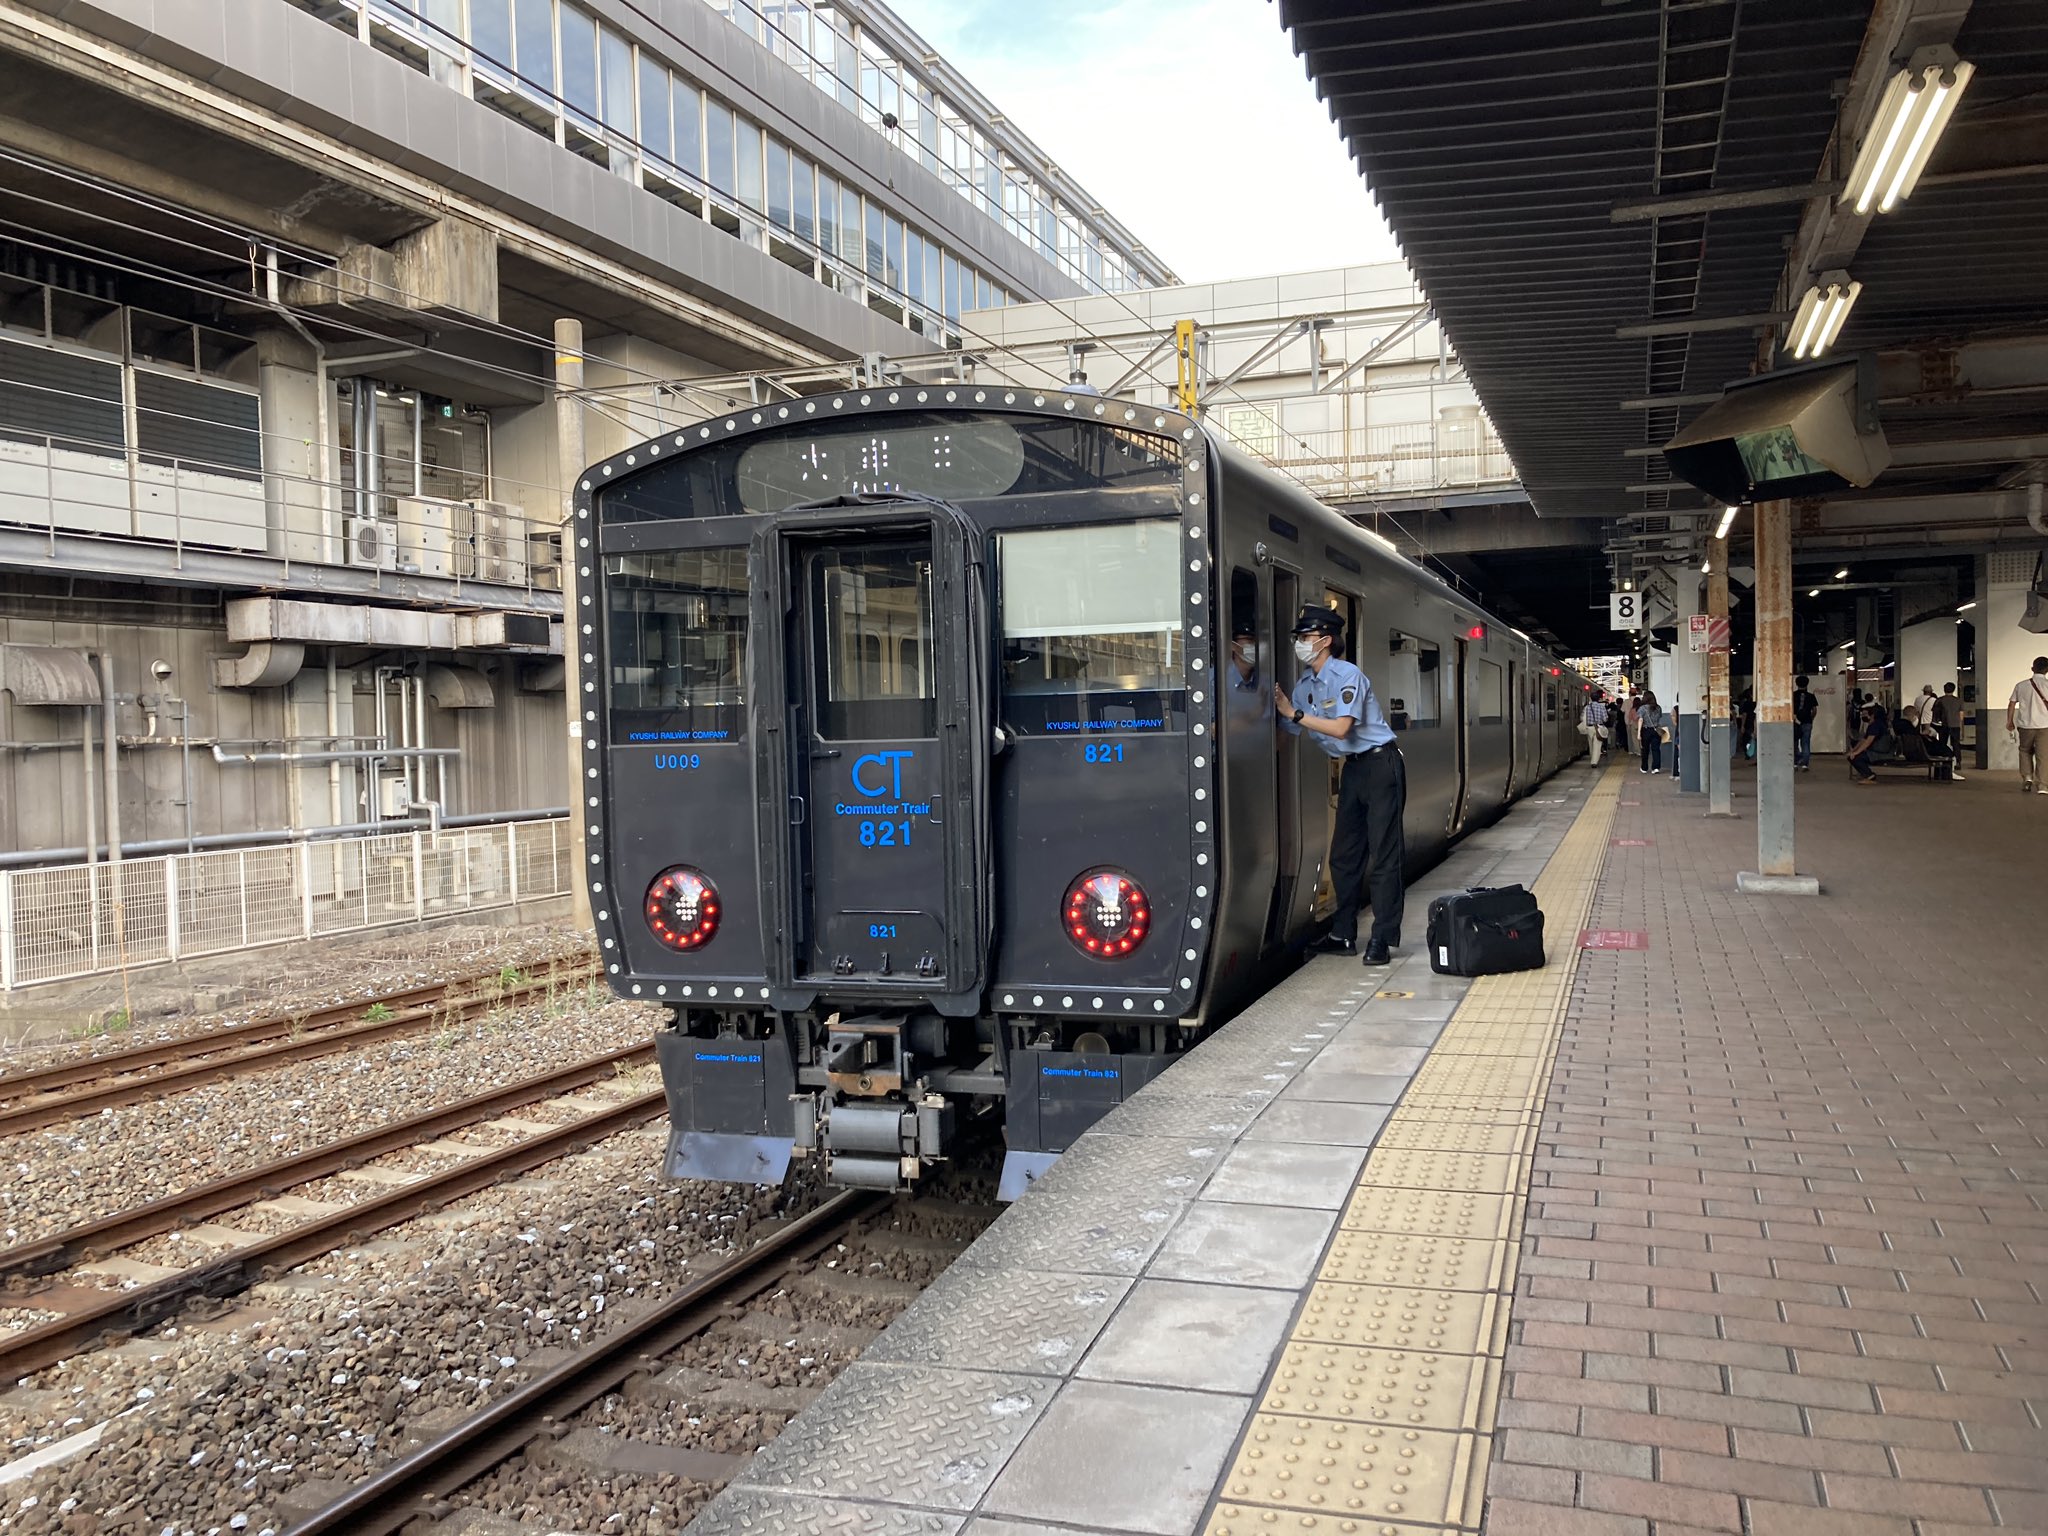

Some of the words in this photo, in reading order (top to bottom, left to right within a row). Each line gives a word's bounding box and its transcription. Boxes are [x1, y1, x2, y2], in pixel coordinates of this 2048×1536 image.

[1619, 596, 1634, 618] 8
[1635, 670, 1641, 680] 8
[1046, 720, 1080, 730] KYUSHU
[1083, 719, 1118, 729] RAILWAY
[1120, 718, 1163, 729] COMPANY
[629, 732, 659, 740] KYUSHU
[660, 731, 690, 740] RAILWAY
[692, 730, 729, 739] COMPANY
[1085, 743, 1124, 763] 821
[655, 754, 700, 769] U009
[851, 750, 914, 799] CT
[835, 802, 899, 815] Commuter
[859, 820, 911, 847] 821
[869, 924, 897, 938] 821
[695, 1053, 730, 1062] Commuter
[730, 1054, 748, 1062] Train
[748, 1055, 761, 1063] 821
[1042, 1066, 1081, 1077] Commuter
[1083, 1068, 1103, 1078] Train
[1104, 1070, 1119, 1078] 821
